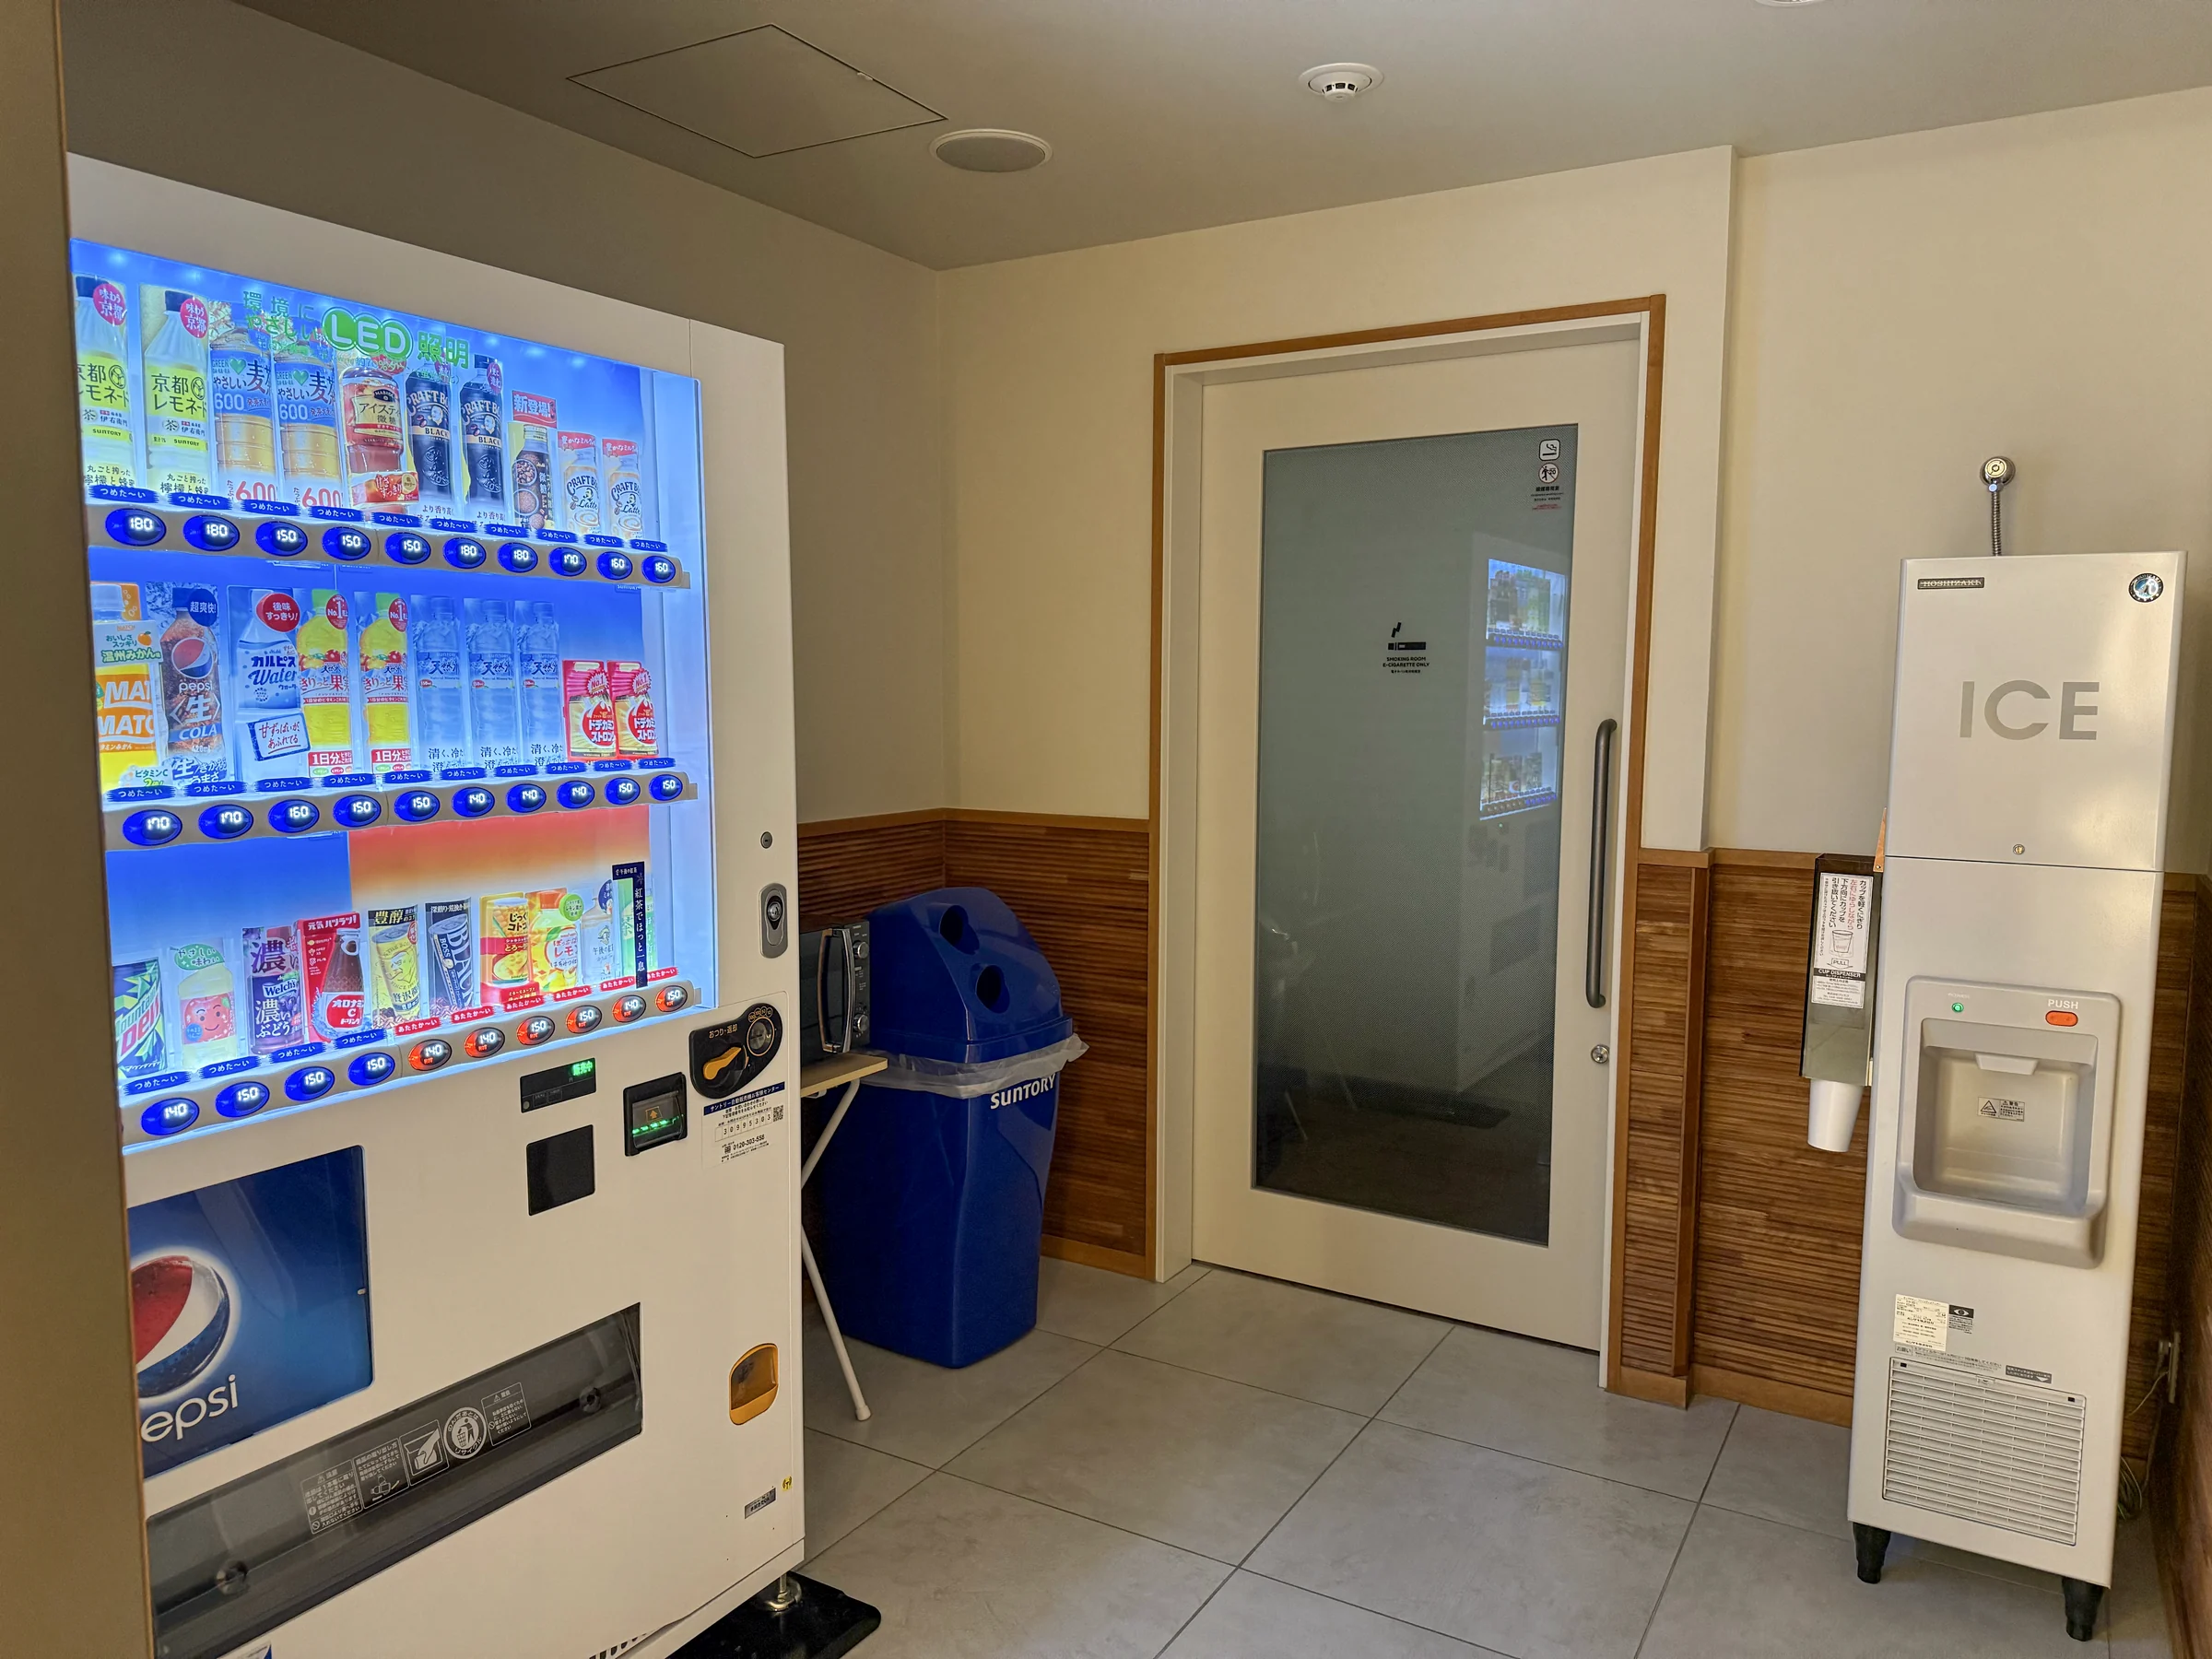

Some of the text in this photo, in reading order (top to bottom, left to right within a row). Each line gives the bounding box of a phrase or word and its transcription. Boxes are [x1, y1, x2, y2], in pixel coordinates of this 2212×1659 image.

[98, 300, 124, 322] 京都
[184, 314, 206, 334] 京都
[331, 313, 469, 370] LED 照明
[150, 373, 190, 395] 京都
[213, 376, 247, 391] やさしい
[277, 388, 311, 401] やさしい
[214, 393, 244, 411] 600
[513, 394, 551, 418] 新登場!
[278, 404, 308, 420] 600
[163, 419, 178, 431] 茶
[377, 415, 396, 426] 微糖
[92, 428, 122, 437] SUNTORY
[173, 439, 200, 447] SUNTORY
[566, 475, 591, 497] CRAFT
[611, 482, 634, 502] CRAFT
[578, 500, 597, 511] Latte
[621, 504, 641, 515] Latte
[129, 517, 153, 531] 180
[206, 524, 229, 537] 180
[276, 530, 297, 542] 150
[342, 535, 361, 547] 150
[404, 540, 421, 551] 150
[460, 546, 477, 556] 180
[513, 550, 529, 560] 180
[611, 559, 625, 568] 160
[654, 562, 668, 571] 160
[1919, 579, 1983, 588] HOSHIZAKI
[190, 601, 217, 614] 超爽快!
[272, 602, 292, 612] 後味
[265, 612, 299, 621] すっきり!
[106, 634, 133, 642] おいしさ
[112, 640, 137, 648] スッキリ
[251, 655, 297, 668] カルピス
[247, 667, 298, 686] Water
[591, 677, 605, 688] No.1
[635, 674, 647, 688] No.1
[179, 680, 213, 693] pepsi
[1959, 679, 2100, 741] ICE
[178, 724, 218, 741] COLA
[267, 734, 299, 749] あふれてる
[135, 769, 169, 778] ビタミンC
[618, 782, 633, 793] 150
[662, 779, 676, 789] 150
[522, 789, 538, 800] 140
[571, 786, 587, 796] 140
[412, 796, 430, 808] 150
[468, 793, 486, 804] 140
[289, 806, 310, 818] 160
[352, 801, 371, 813] 150
[147, 817, 171, 830] 170
[220, 811, 242, 824] 170
[633, 888, 646, 972] 紅茶でほっと一息
[178, 948, 216, 959] やさしい
[440, 937, 452, 959] BOSS
[192, 957, 220, 967] 味わい
[1830, 970, 1862, 978] DISPENSER
[265, 980, 297, 996] Welch's
[667, 989, 680, 1000] 150
[625, 999, 639, 1009] 140
[2047, 998, 2080, 1010] PUSH
[254, 999, 291, 1025] 濃い
[347, 1009, 357, 1018] C
[580, 1009, 594, 1020] 150
[340, 1018, 360, 1026] ドリンク
[531, 1020, 547, 1031] 150
[255, 1020, 291, 1039] ぶどう
[708, 1023, 739, 1040] おつり・返却
[479, 1032, 496, 1043] 140
[425, 1044, 442, 1057] 140
[367, 1057, 385, 1071] 150
[304, 1071, 324, 1086] 150
[237, 1087, 259, 1101] 150
[990, 1073, 1056, 1110] SUNTORY
[164, 1102, 188, 1120] 140
[140, 1374, 239, 1443] epsi
[454, 1436, 482, 1455] リサイクル
